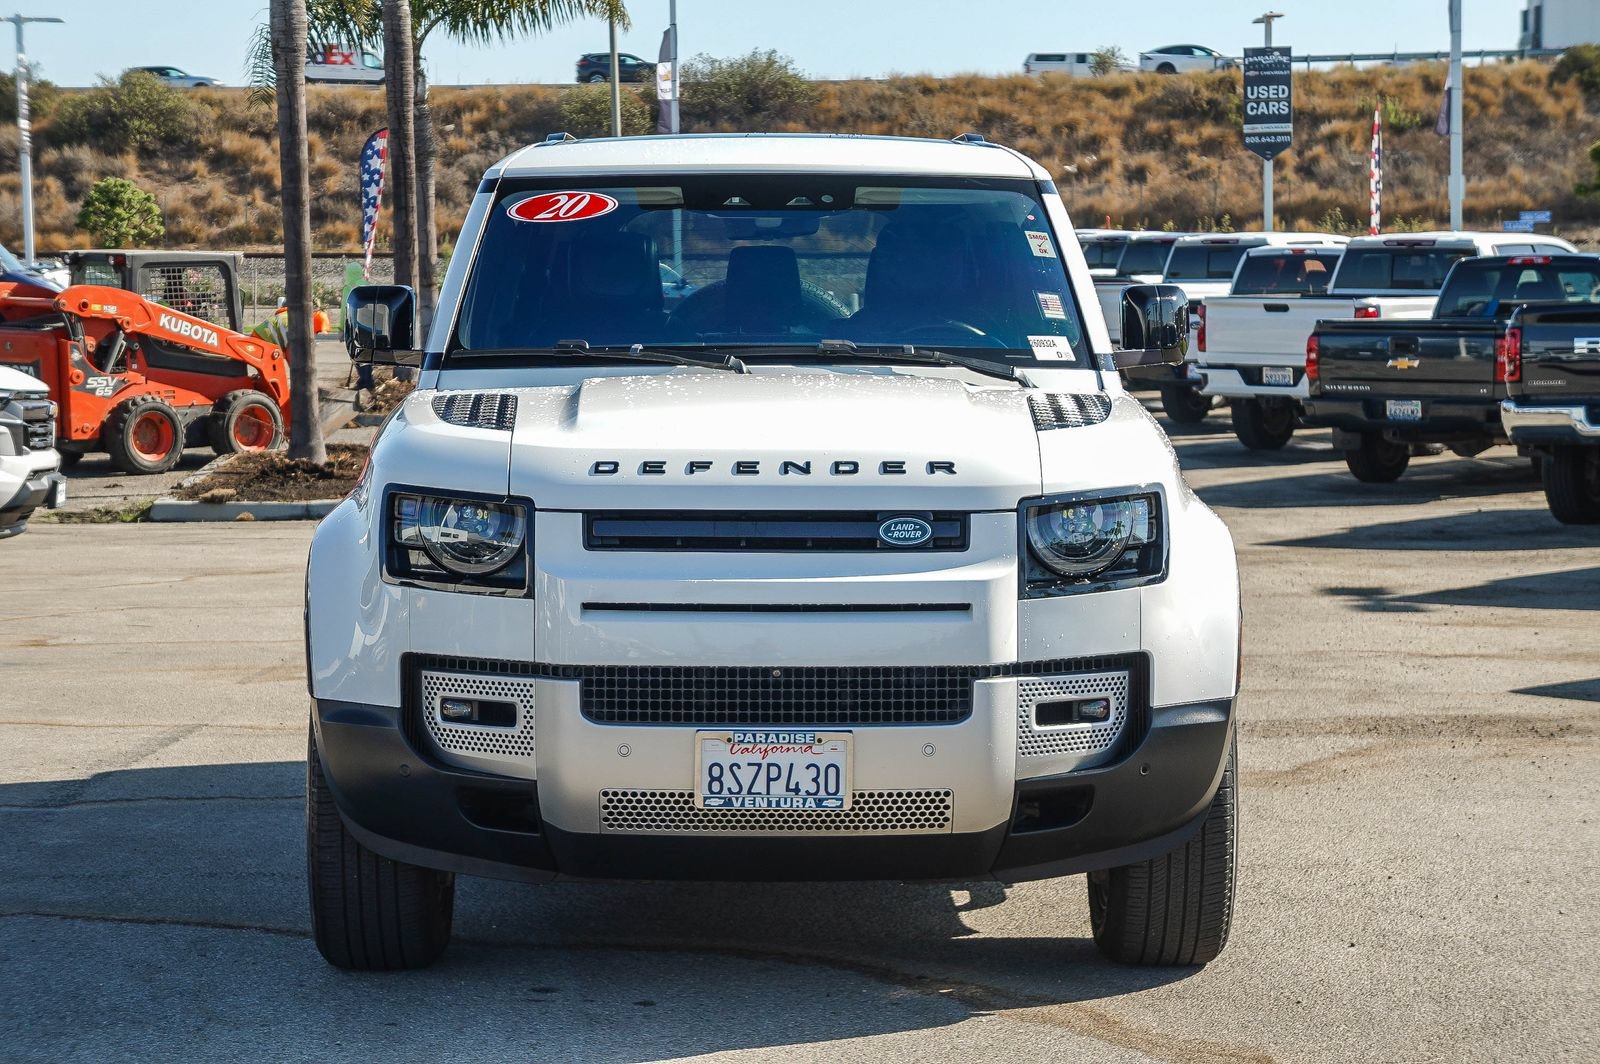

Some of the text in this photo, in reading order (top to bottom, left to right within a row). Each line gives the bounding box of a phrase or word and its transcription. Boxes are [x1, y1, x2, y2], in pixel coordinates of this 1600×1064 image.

[1247, 84, 1289, 99] USED
[1246, 101, 1289, 115] CARS
[533, 193, 591, 219] 20
[1027, 233, 1048, 241] SMOG
[159, 313, 218, 346] KUBOTA
[86, 376, 117, 388] SSV
[95, 386, 113, 396] 65
[594, 460, 958, 475] DEFENDER
[734, 733, 815, 744] PARADISE
[729, 743, 824, 761] California
[707, 762, 841, 796] 8SZP430
[731, 797, 817, 809] VENTURA
